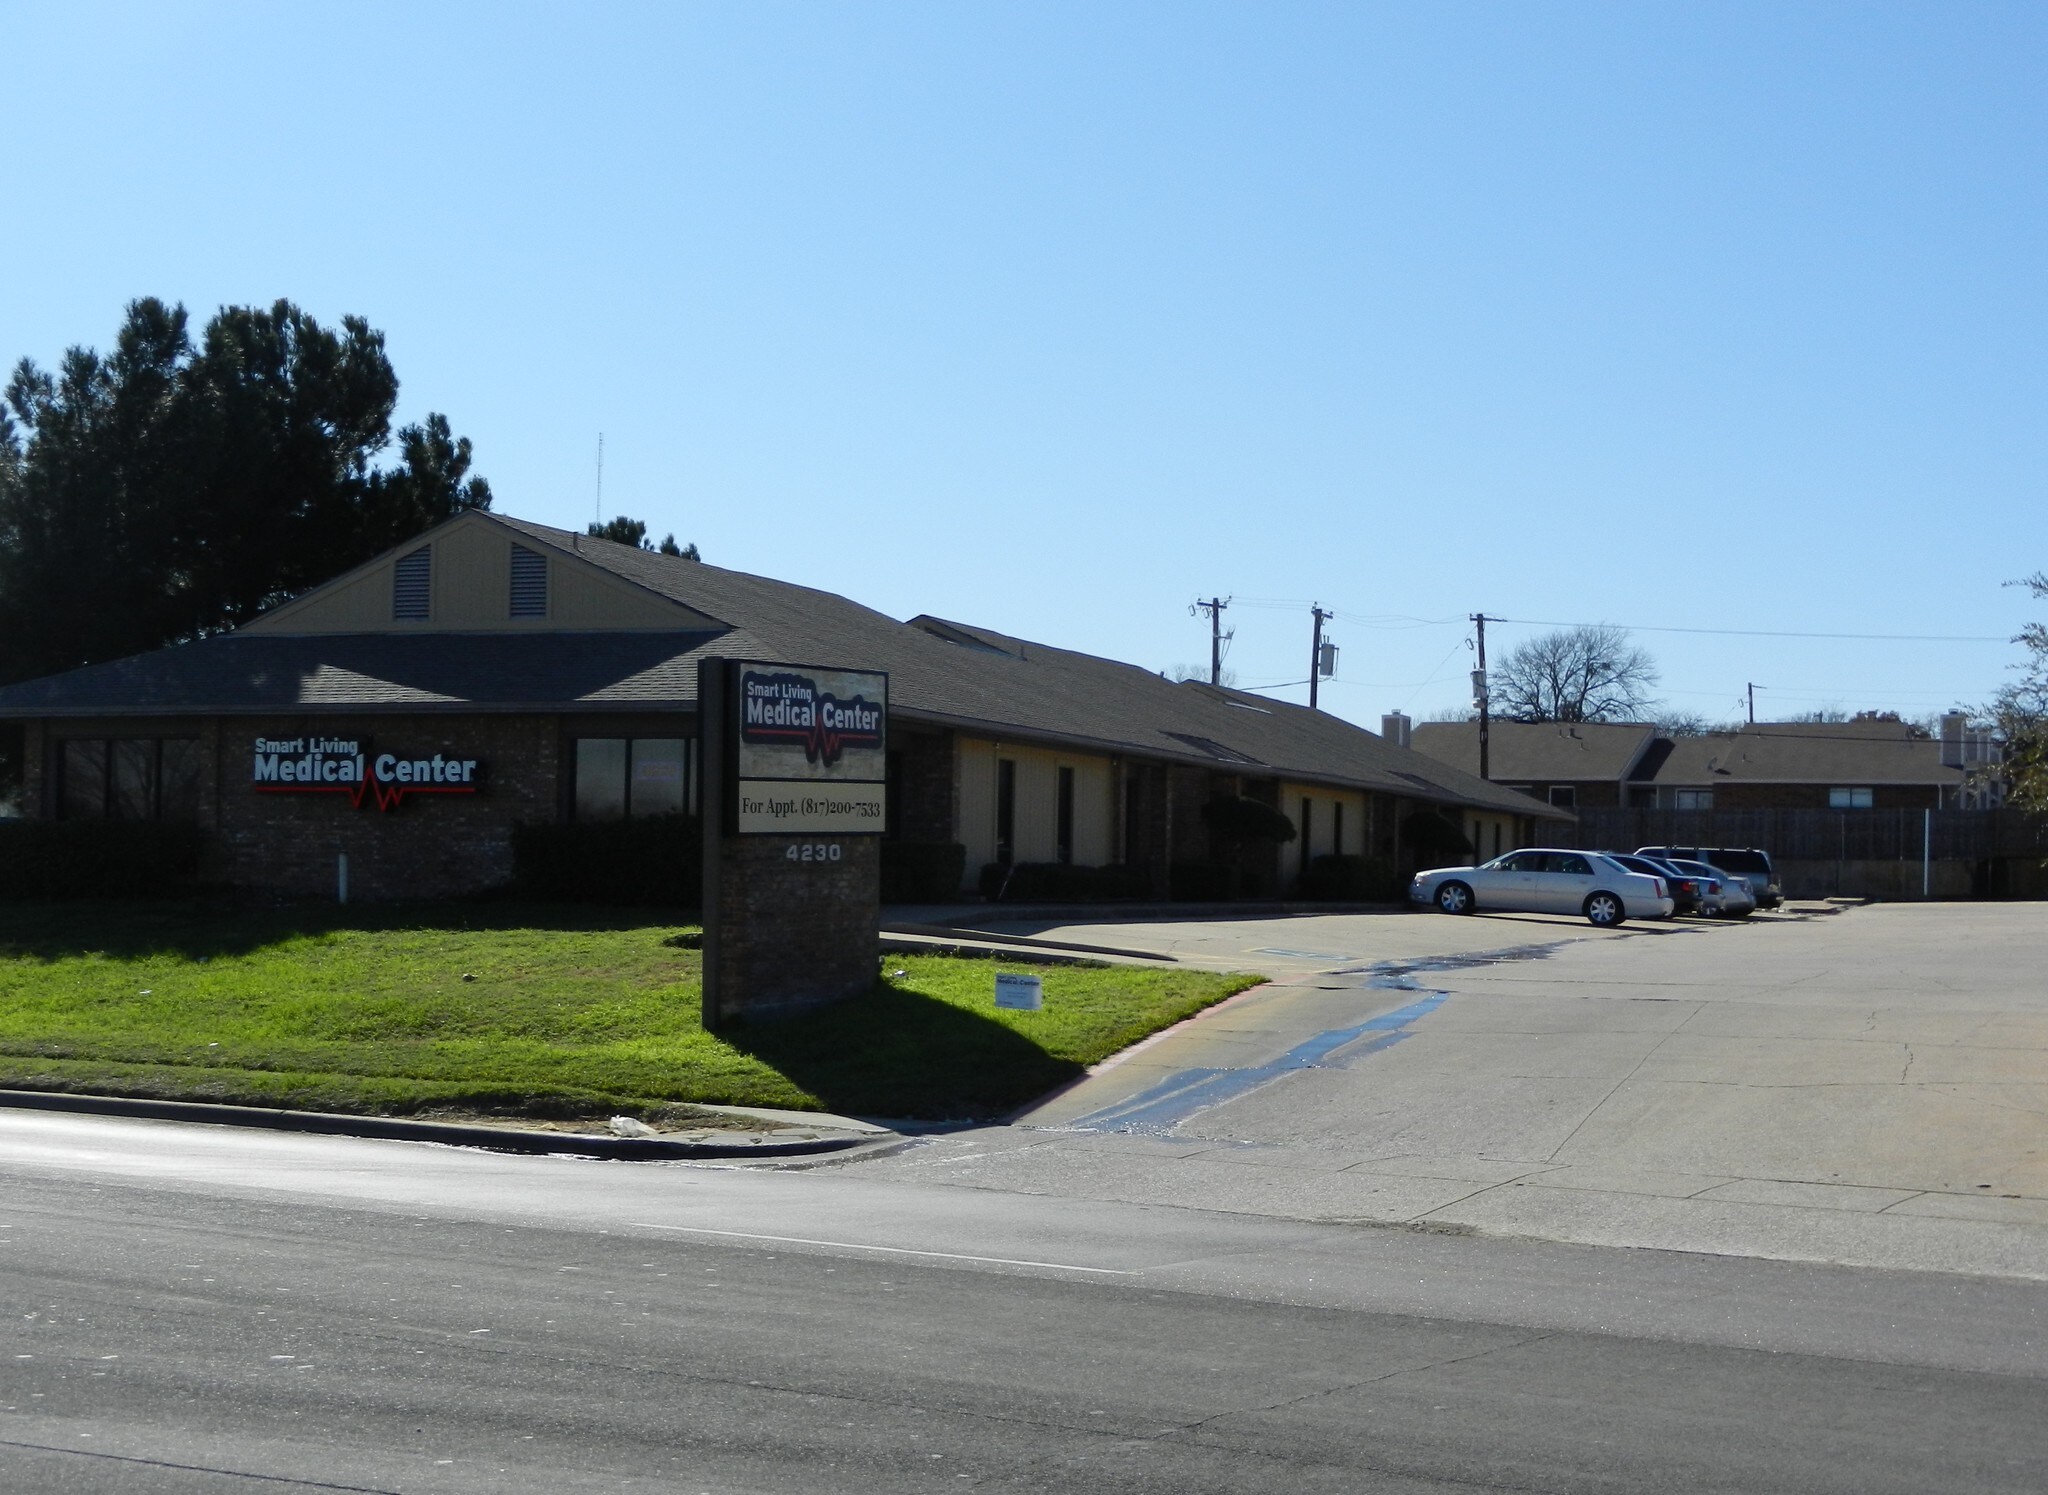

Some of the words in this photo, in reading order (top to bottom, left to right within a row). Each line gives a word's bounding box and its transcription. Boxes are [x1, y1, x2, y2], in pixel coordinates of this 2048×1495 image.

[747, 681, 779, 698] Smart
[782, 683, 812, 703] Living
[747, 697, 816, 727] Medical
[822, 702, 879, 730] Center
[255, 737, 304, 753] Smart
[309, 736, 359, 757] Living
[254, 753, 365, 782] Medical
[375, 753, 477, 782] Center
[742, 798, 764, 815] For
[766, 797, 798, 818] Appt.
[786, 844, 841, 861] 4230
